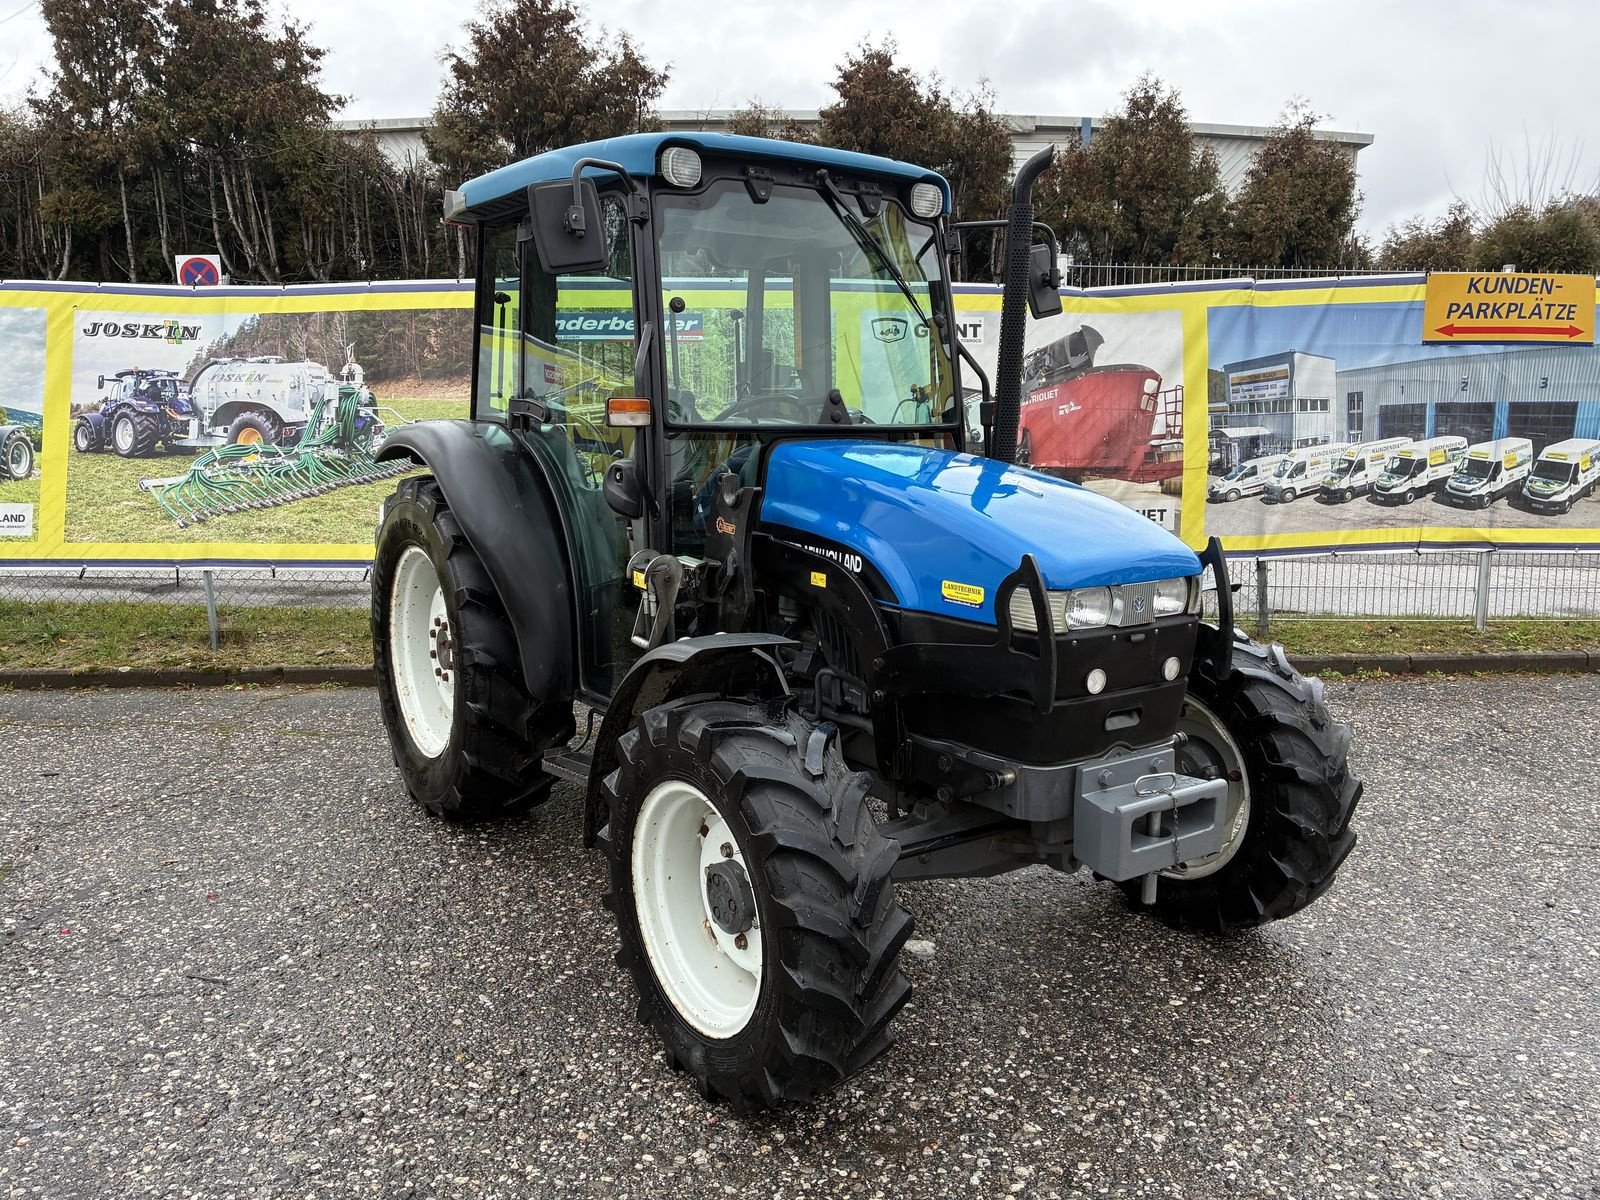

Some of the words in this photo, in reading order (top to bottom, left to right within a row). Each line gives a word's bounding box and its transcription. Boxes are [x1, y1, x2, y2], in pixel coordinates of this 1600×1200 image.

[1466, 277, 1563, 295] KUNDEN-
[1446, 297, 1577, 321] PARKPLÄTZE
[83, 322, 201, 341] JOSKIN
[1460, 379, 1469, 392] 2
[1539, 377, 1549, 389] 3
[1400, 385, 1405, 396] 1
[943, 582, 982, 596] LANDTECHNIK
